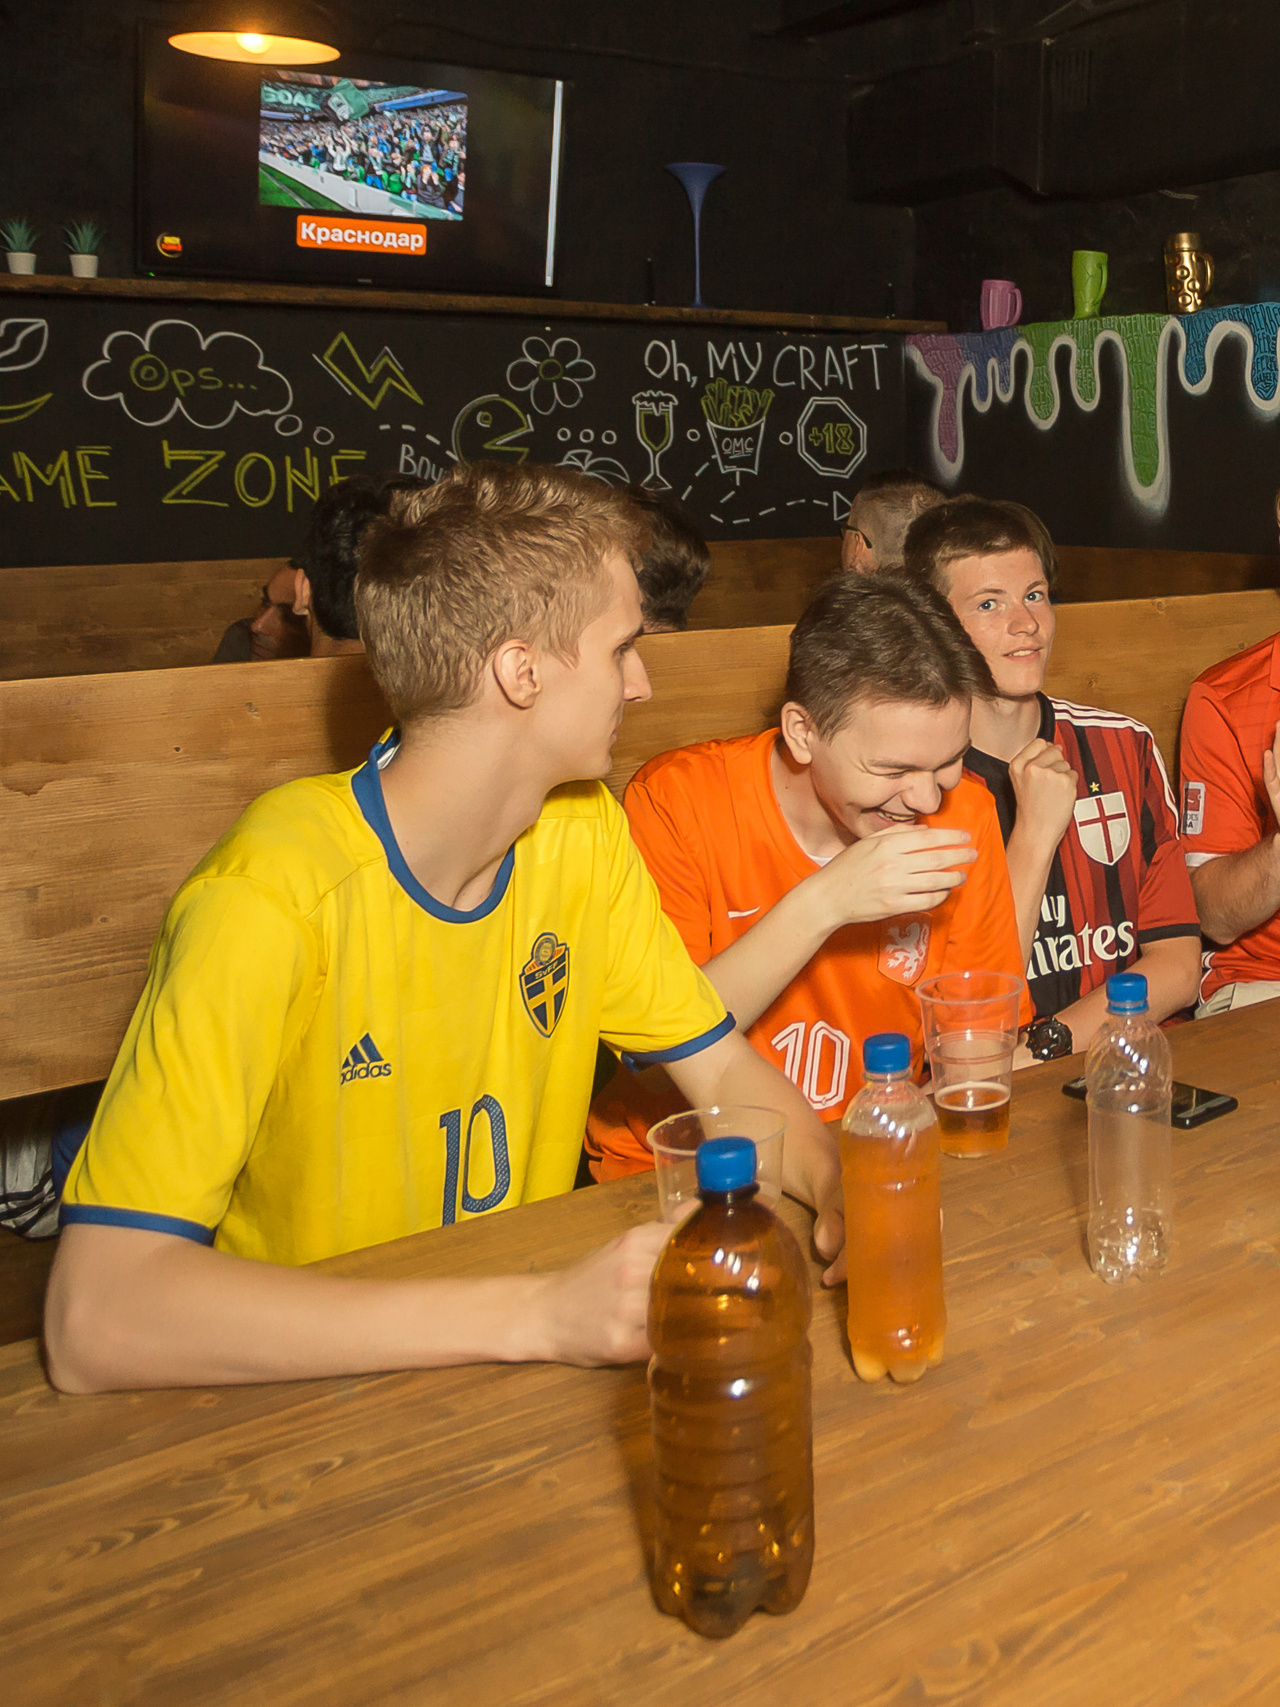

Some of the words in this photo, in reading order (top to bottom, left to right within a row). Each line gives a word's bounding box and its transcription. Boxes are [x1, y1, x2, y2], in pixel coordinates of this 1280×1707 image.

[300, 222, 424, 250] Краснодар
[644, 339, 697, 388] Oh,
[708, 341, 762, 384] MY
[773, 344, 888, 391] CRAFT
[722, 436, 754, 456] OMC
[809, 422, 854, 455] +18
[1041, 894, 1066, 928] ly
[1026, 921, 1135, 980] irates
[771, 1020, 851, 1110] 10
[438, 1094, 511, 1227] 10
